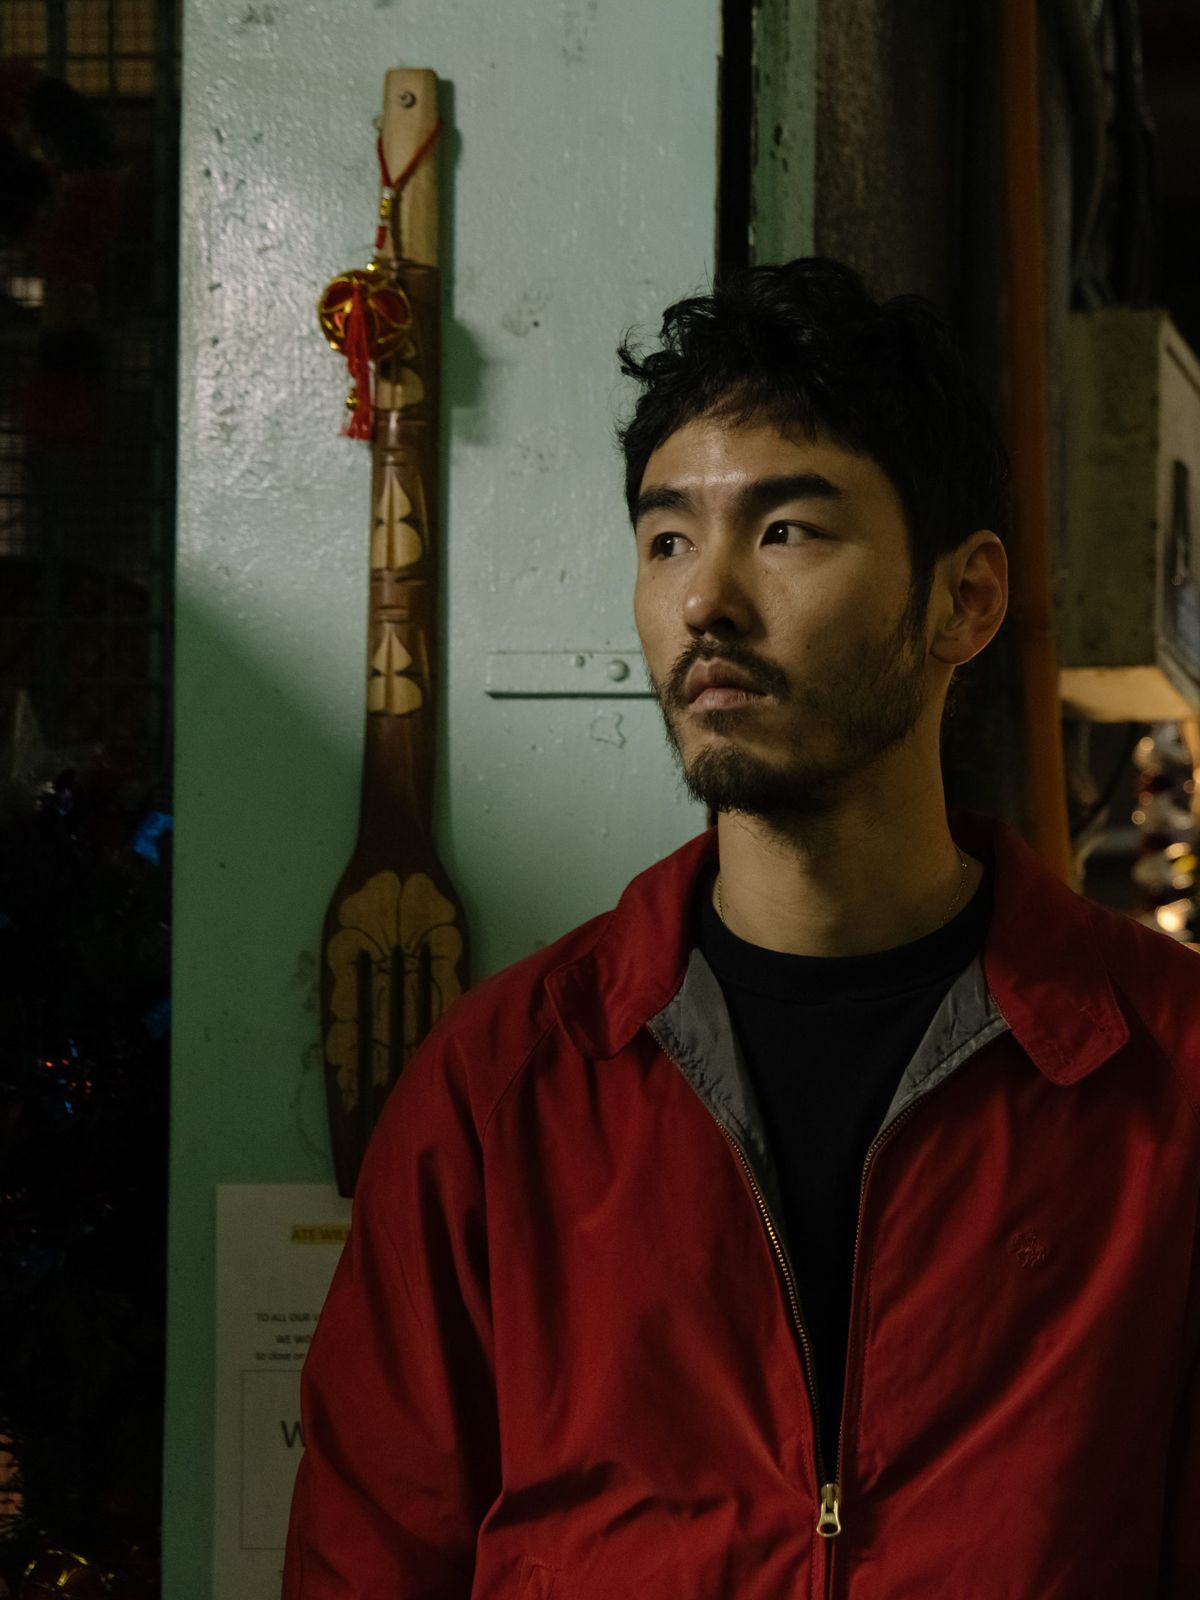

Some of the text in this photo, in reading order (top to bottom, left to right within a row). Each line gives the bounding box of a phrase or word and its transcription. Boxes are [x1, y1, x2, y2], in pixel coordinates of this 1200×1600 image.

[256, 1313, 270, 1322] TO
[271, 1313, 287, 1322] ALL
[290, 1313, 310, 1322] OUR
